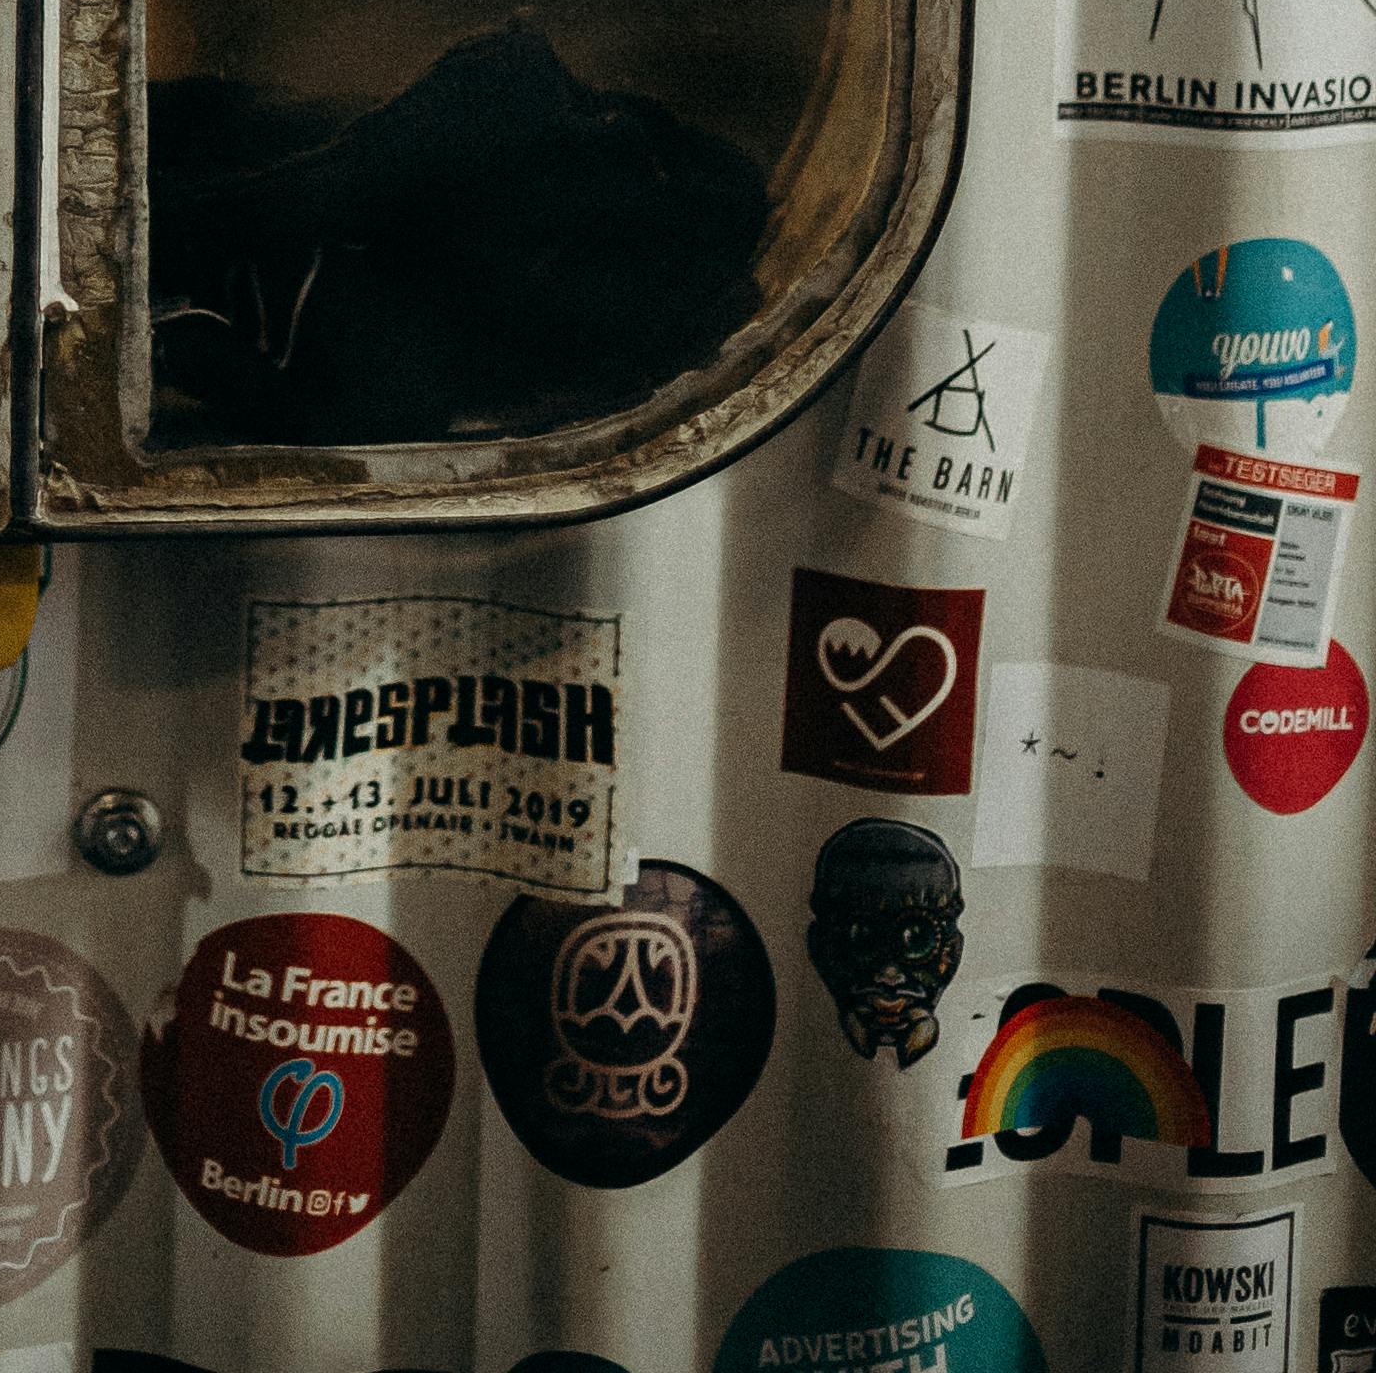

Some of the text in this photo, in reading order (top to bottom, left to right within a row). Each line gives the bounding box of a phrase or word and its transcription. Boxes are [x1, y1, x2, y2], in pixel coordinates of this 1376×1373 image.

[1075, 69, 1373, 110] BERLIN INVASIO
[1211, 326, 1312, 379] youvo
[856, 424, 1014, 504] THE BARN
[1239, 704, 1354, 737] CODEMILL
[258, 783, 314, 816] 12.
[348, 780, 395, 810] 13.
[407, 775, 492, 809] JULI
[505, 785, 591, 829] 2019
[273, 818, 362, 840] REGGAE
[372, 810, 474, 834] OPENAIR
[221, 949, 419, 1015] La France
[209, 991, 419, 1060] insoumise
[200, 1159, 304, 1216] Berlin
[1162, 1259, 1276, 1304] KOWSKI
[759, 1292, 975, 1369] ADVERTISING
[1161, 1322, 1274, 1356] MOABIT
